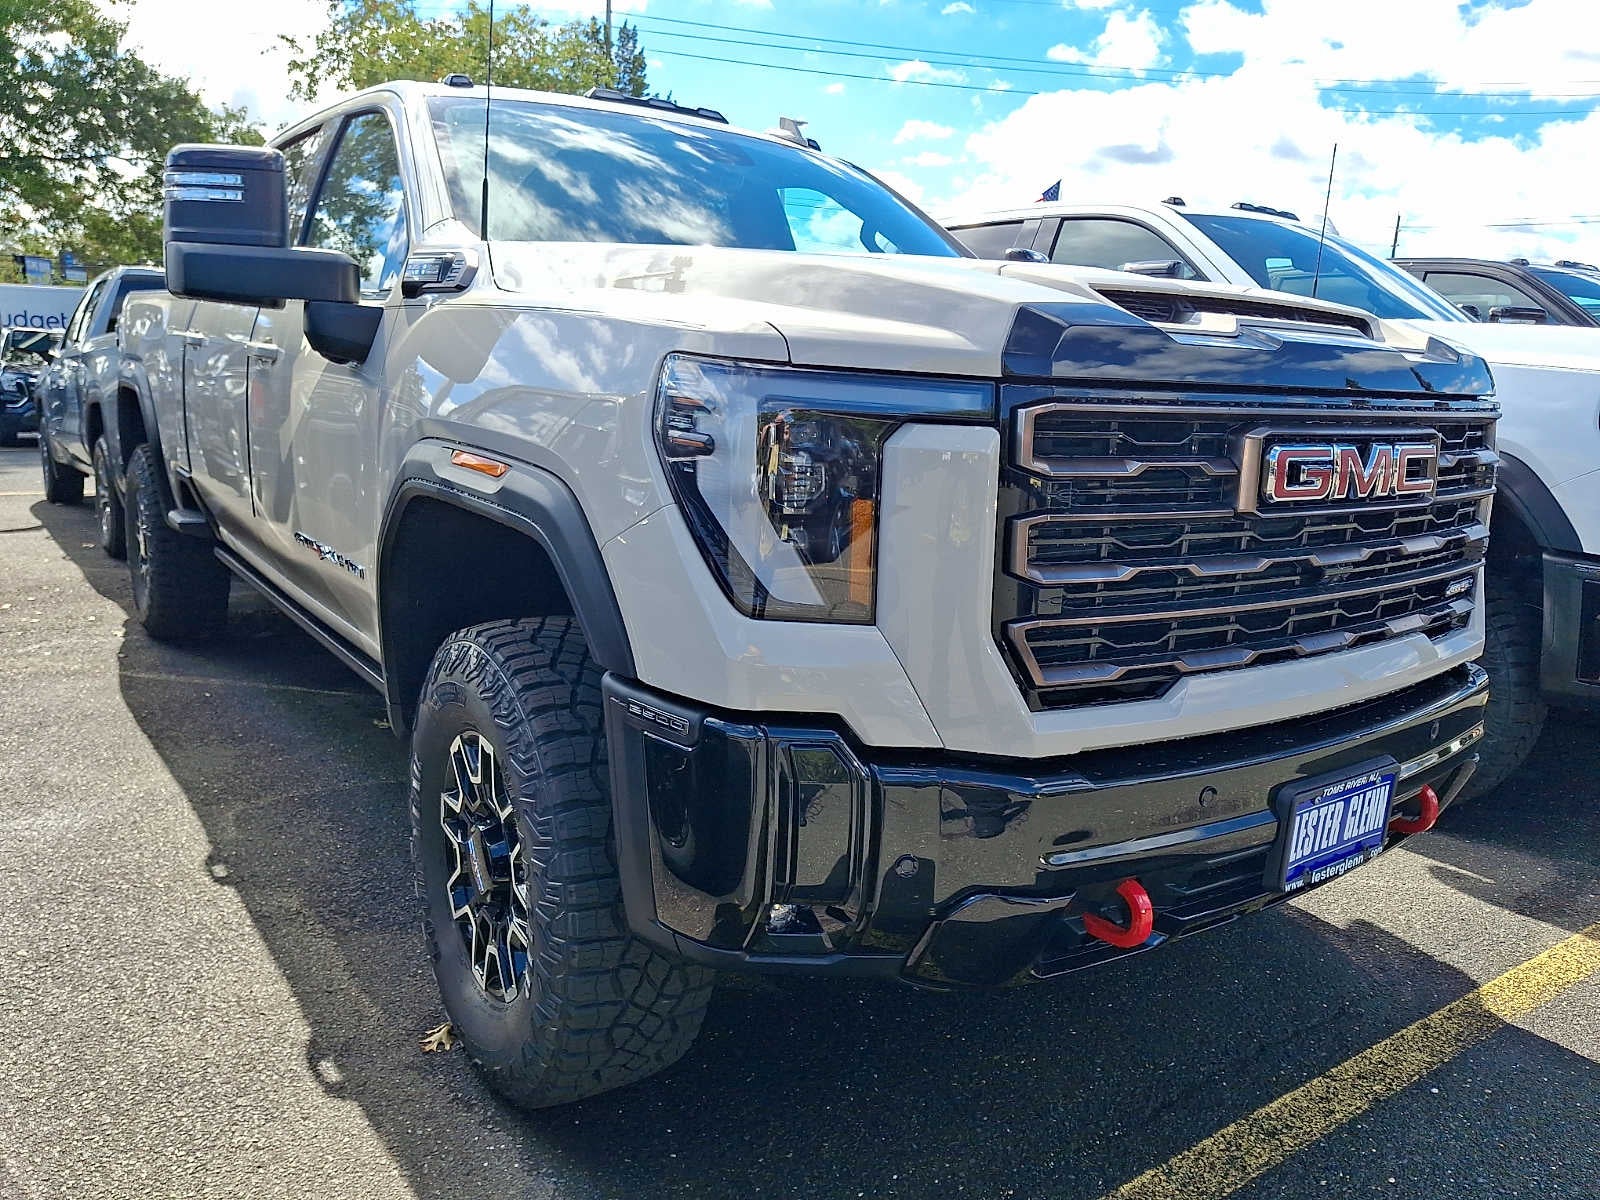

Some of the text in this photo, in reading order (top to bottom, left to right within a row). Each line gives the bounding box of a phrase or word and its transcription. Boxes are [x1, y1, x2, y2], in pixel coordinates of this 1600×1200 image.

[1266, 443, 1437, 502] GMC
[1323, 784, 1345, 797] TOMS
[1289, 785, 1390, 862] LESTER GLENN
[1311, 855, 1363, 883] lesterglenn
